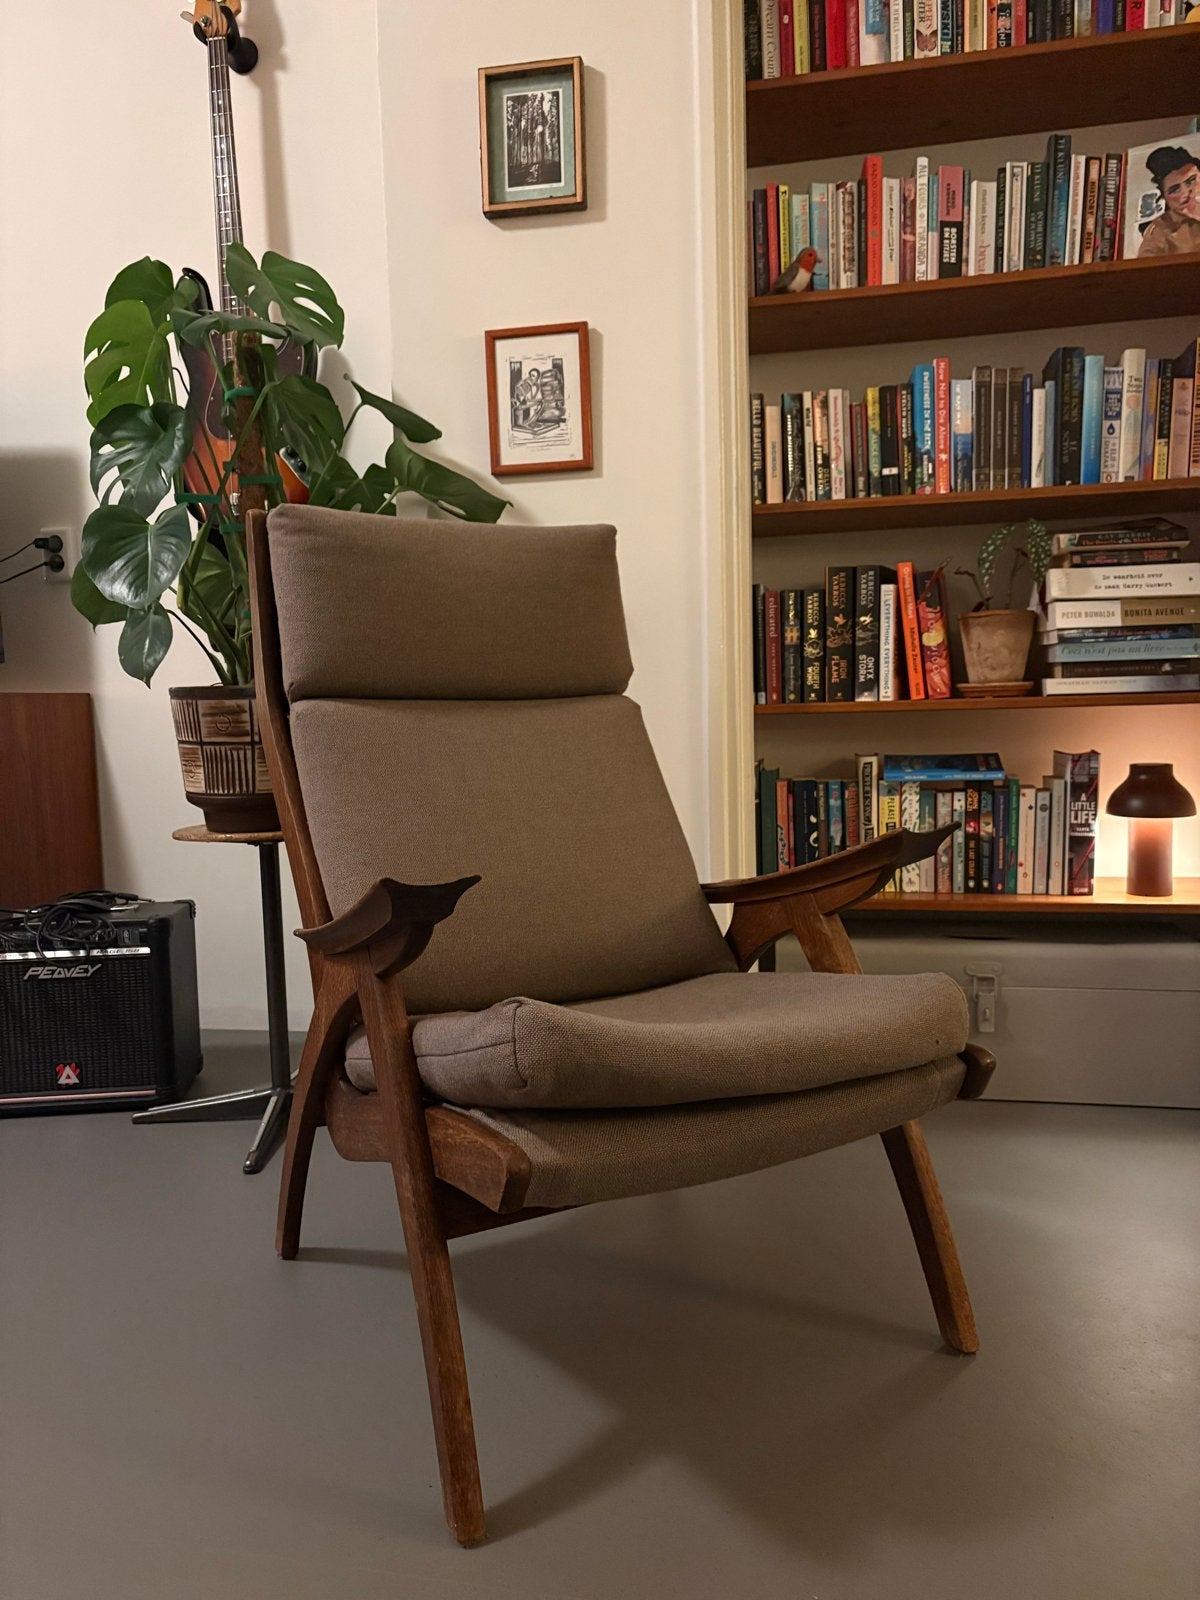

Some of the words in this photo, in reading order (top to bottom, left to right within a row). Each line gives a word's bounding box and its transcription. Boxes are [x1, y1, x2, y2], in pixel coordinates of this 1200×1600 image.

[999, 12, 1007, 47] ISLAND
[918, 164, 927, 177] ALL
[1056, 151, 1065, 184] KLUNE
[1033, 175, 1042, 202] KLUNE
[1088, 181, 1096, 216] HISTORY
[1104, 194, 1115, 220] JUSTICE
[943, 227, 950, 239] EN
[1085, 231, 1093, 250] BEES
[978, 244, 991, 273] brea
[938, 362, 947, 381] How
[1128, 375, 1143, 383] Two
[938, 382, 948, 399] Not
[752, 399, 761, 425] HELLO
[939, 400, 947, 408] to
[939, 410, 948, 424] Die
[939, 425, 948, 449] Alone
[753, 427, 762, 472] BEAUTIFUL
[860, 573, 868, 606] YARROS
[867, 570, 875, 608] REBECCA
[903, 566, 911, 589] Crying
[832, 575, 840, 607] YARROS
[839, 572, 847, 609] REBECCA
[768, 597, 779, 638] educated
[812, 592, 820, 626] REBECCA
[1061, 611, 1083, 619] PETER
[1084, 610, 1116, 619] BUWALDA
[1124, 608, 1152, 618] BONITA
[1155, 607, 1184, 616] AVENUE
[910, 627, 918, 653] Michelle
[1107, 646, 1126, 656] pas
[806, 666, 814, 686] WING
[831, 655, 840, 683] FLAME
[839, 659, 847, 679] IRON
[858, 654, 867, 683] STORM
[866, 656, 875, 680] ONYX
[863, 764, 872, 797] PROPHET
[887, 797, 896, 820] PLEASE
[1071, 801, 1096, 811] LITTLE
[1080, 793, 1087, 801] A
[1071, 811, 1095, 824] LIFE
[23, 963, 102, 981] PEAVEY
